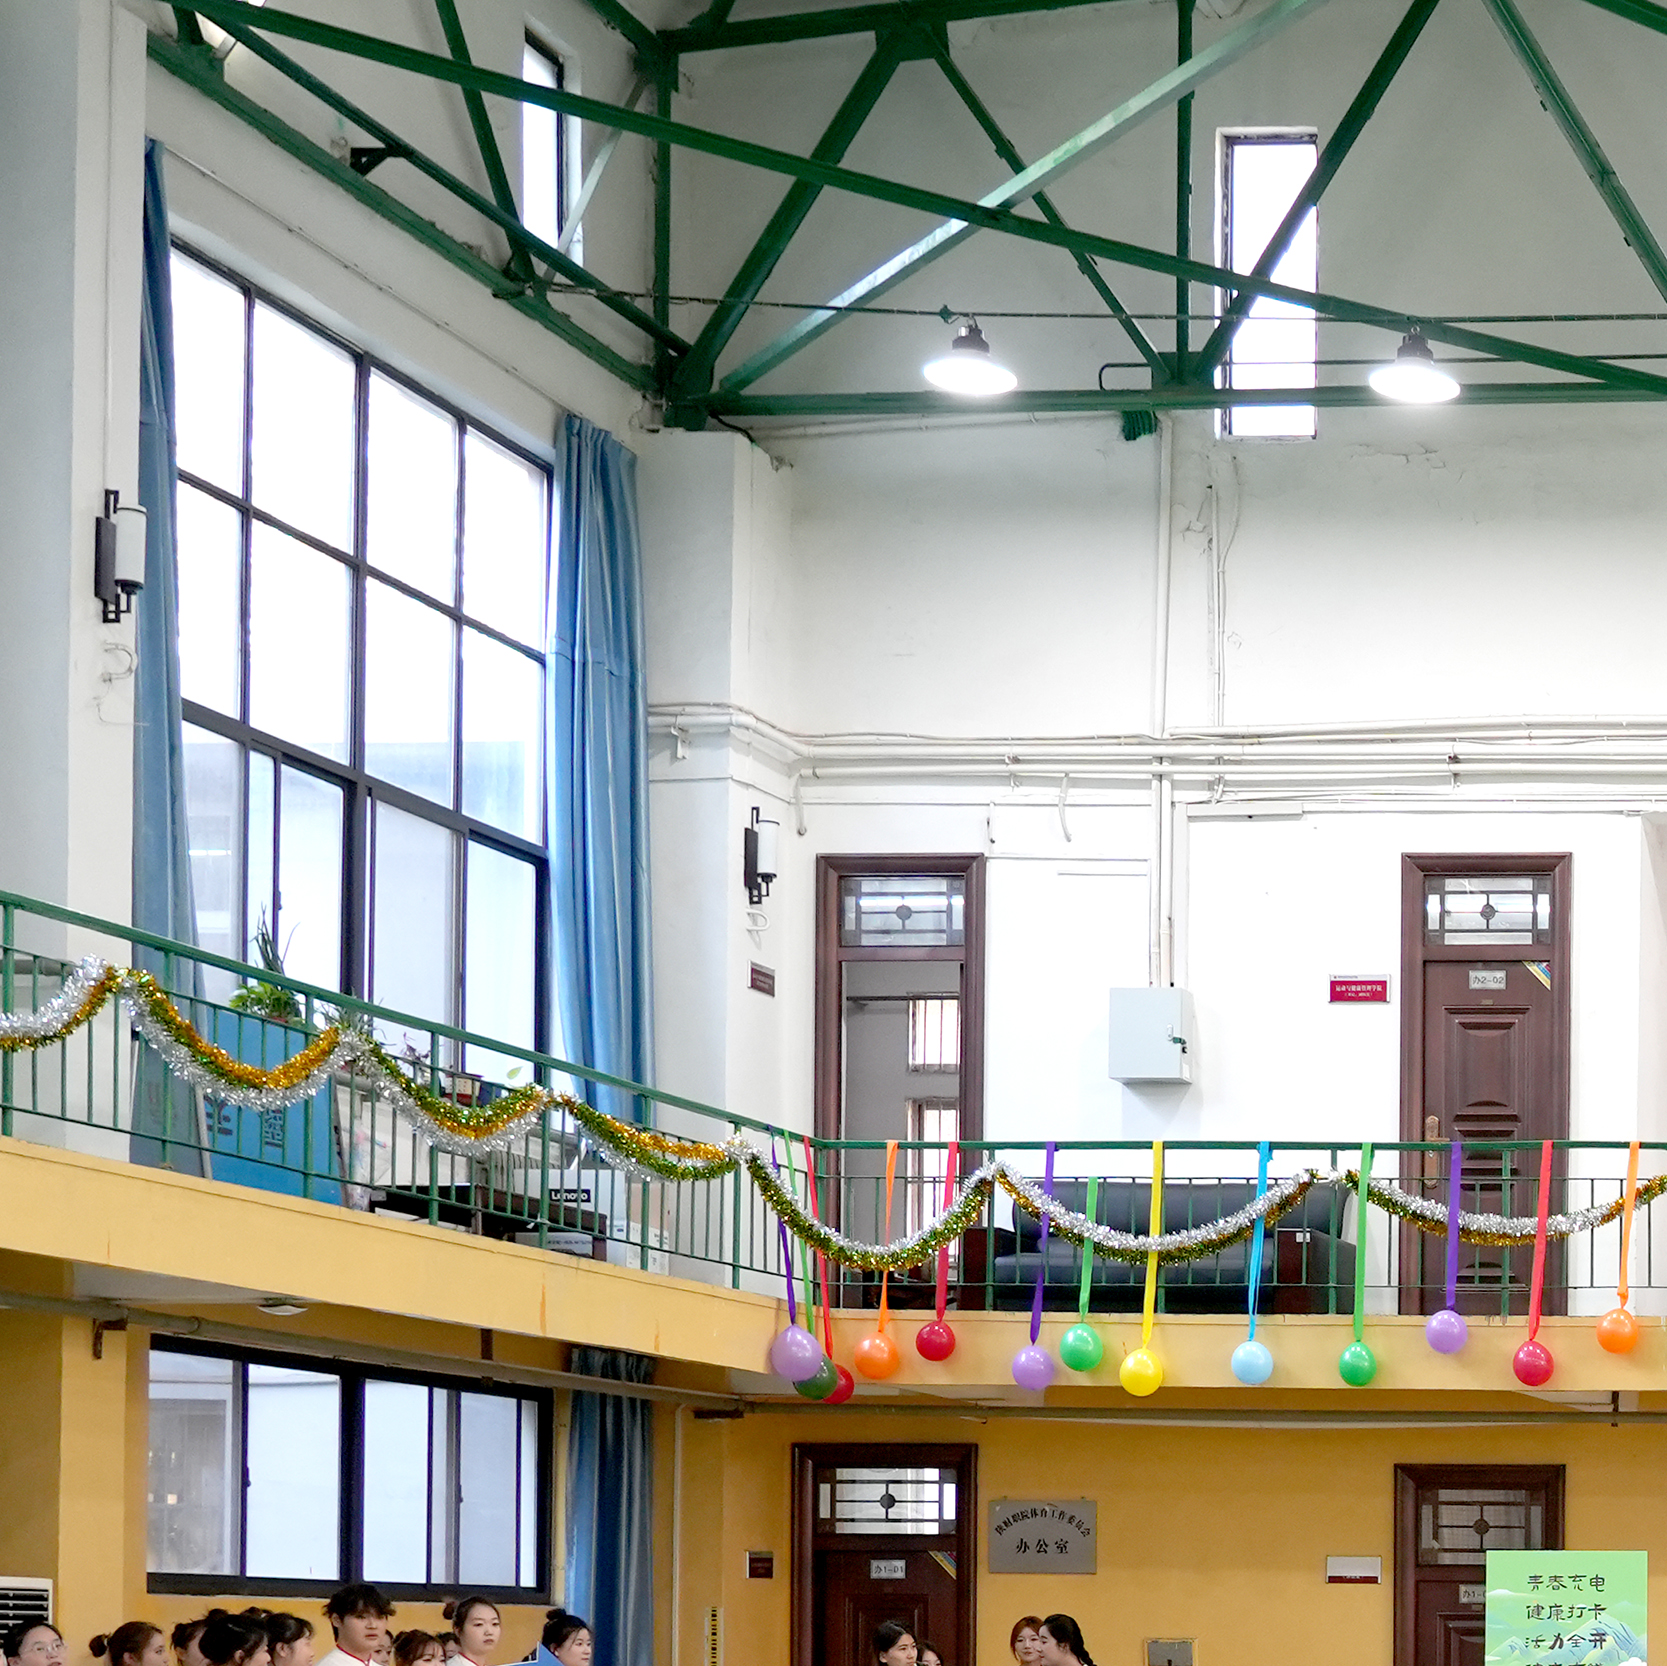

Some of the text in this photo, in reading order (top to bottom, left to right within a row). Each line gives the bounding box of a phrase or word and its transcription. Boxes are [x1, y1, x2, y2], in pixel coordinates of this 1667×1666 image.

[1473, 976, 1504, 985] 办2-02
[551, 1191, 588, 1200] Lnoo
[1016, 1538, 1069, 1554] 办公室
[1527, 1574, 1606, 1592] 青春充电
[1526, 1604, 1607, 1621] 健康打卡
[1525, 1632, 1607, 1650] 活力全开
